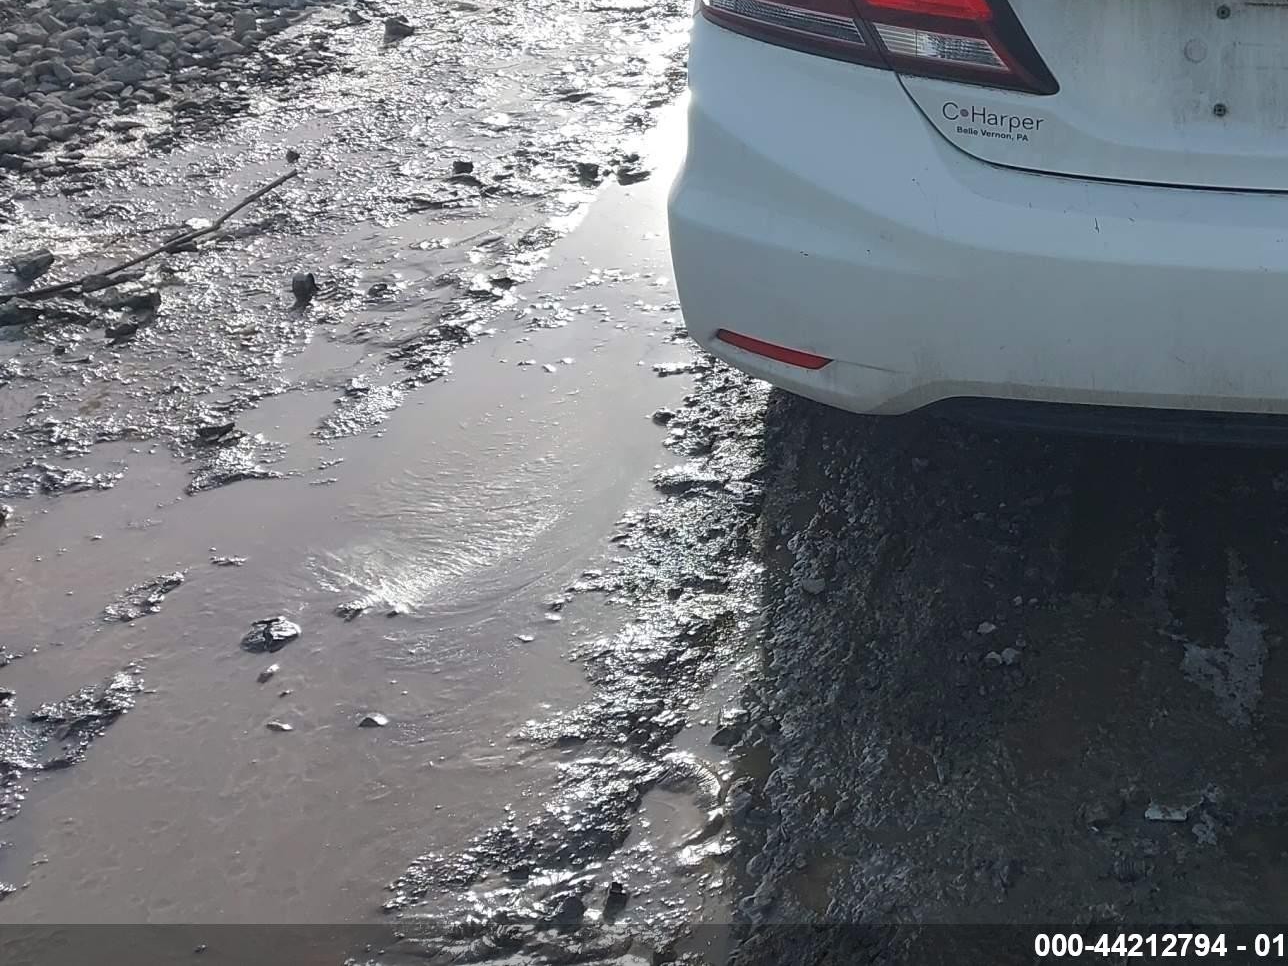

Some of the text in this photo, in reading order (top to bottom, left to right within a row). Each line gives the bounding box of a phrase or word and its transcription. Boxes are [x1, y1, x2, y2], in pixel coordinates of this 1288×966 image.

[956, 125, 1029, 142] Belle Vernon, PA
